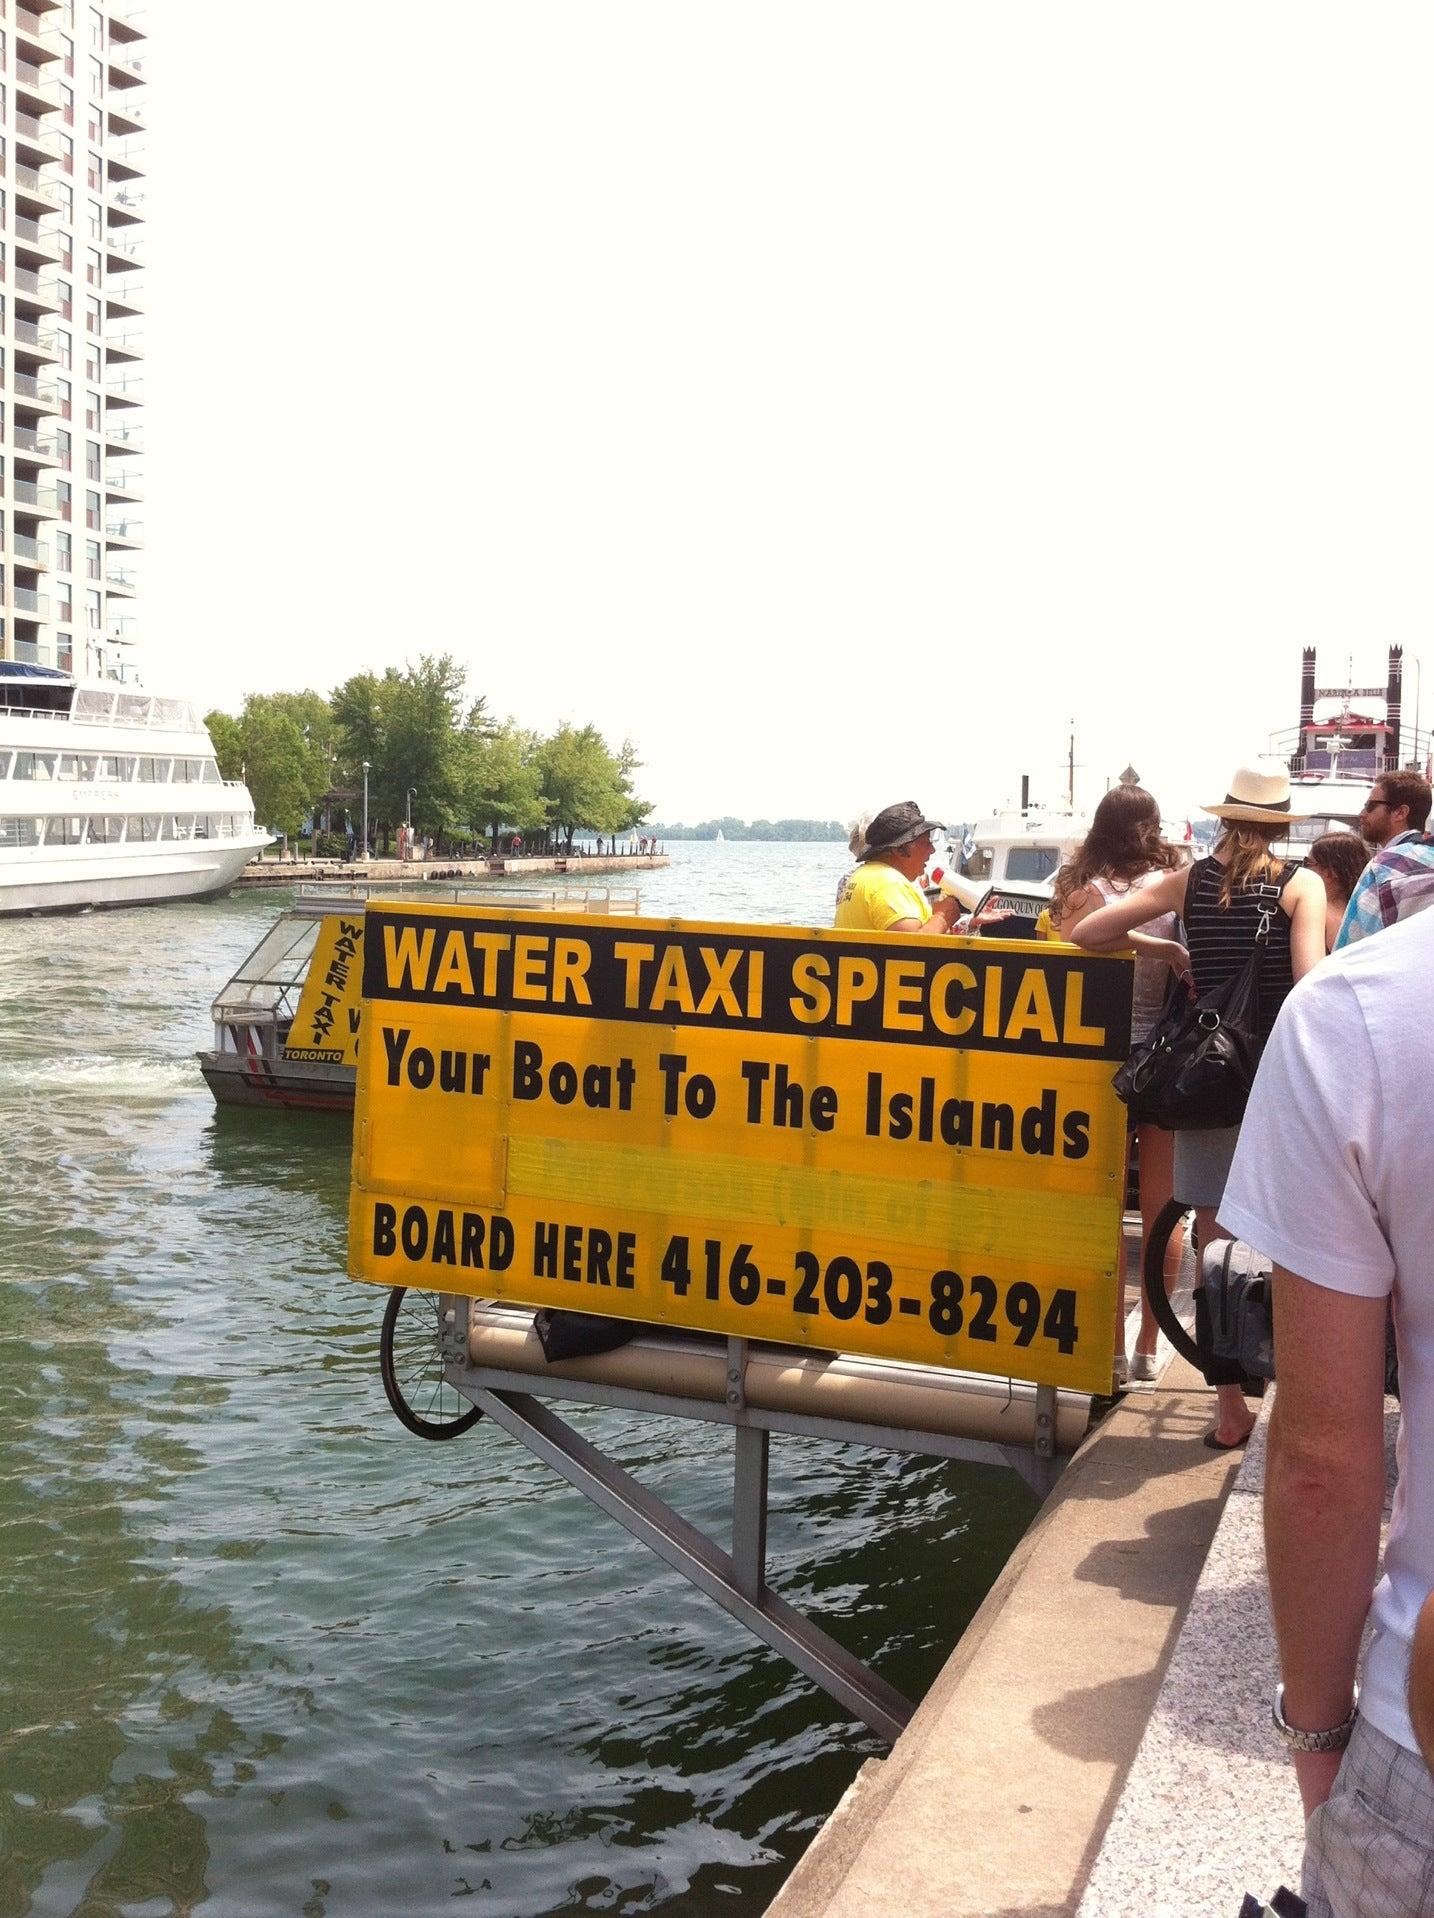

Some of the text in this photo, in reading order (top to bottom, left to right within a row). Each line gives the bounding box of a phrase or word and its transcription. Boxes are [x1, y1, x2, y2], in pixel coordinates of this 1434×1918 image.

[993, 899, 1033, 914] GONQUIN
[310, 920, 363, 1046] WATER TAXI
[384, 925, 1106, 1047] WATER TAXI SPECIAL
[285, 1050, 343, 1061] TORONTO
[382, 1027, 490, 1096] Your
[513, 1040, 636, 1111] Boat
[659, 1053, 716, 1120] To
[742, 1060, 838, 1132] The
[866, 1071, 1090, 1160] Islands
[373, 1202, 1080, 1356] BOARD HERE 416-203-8294
